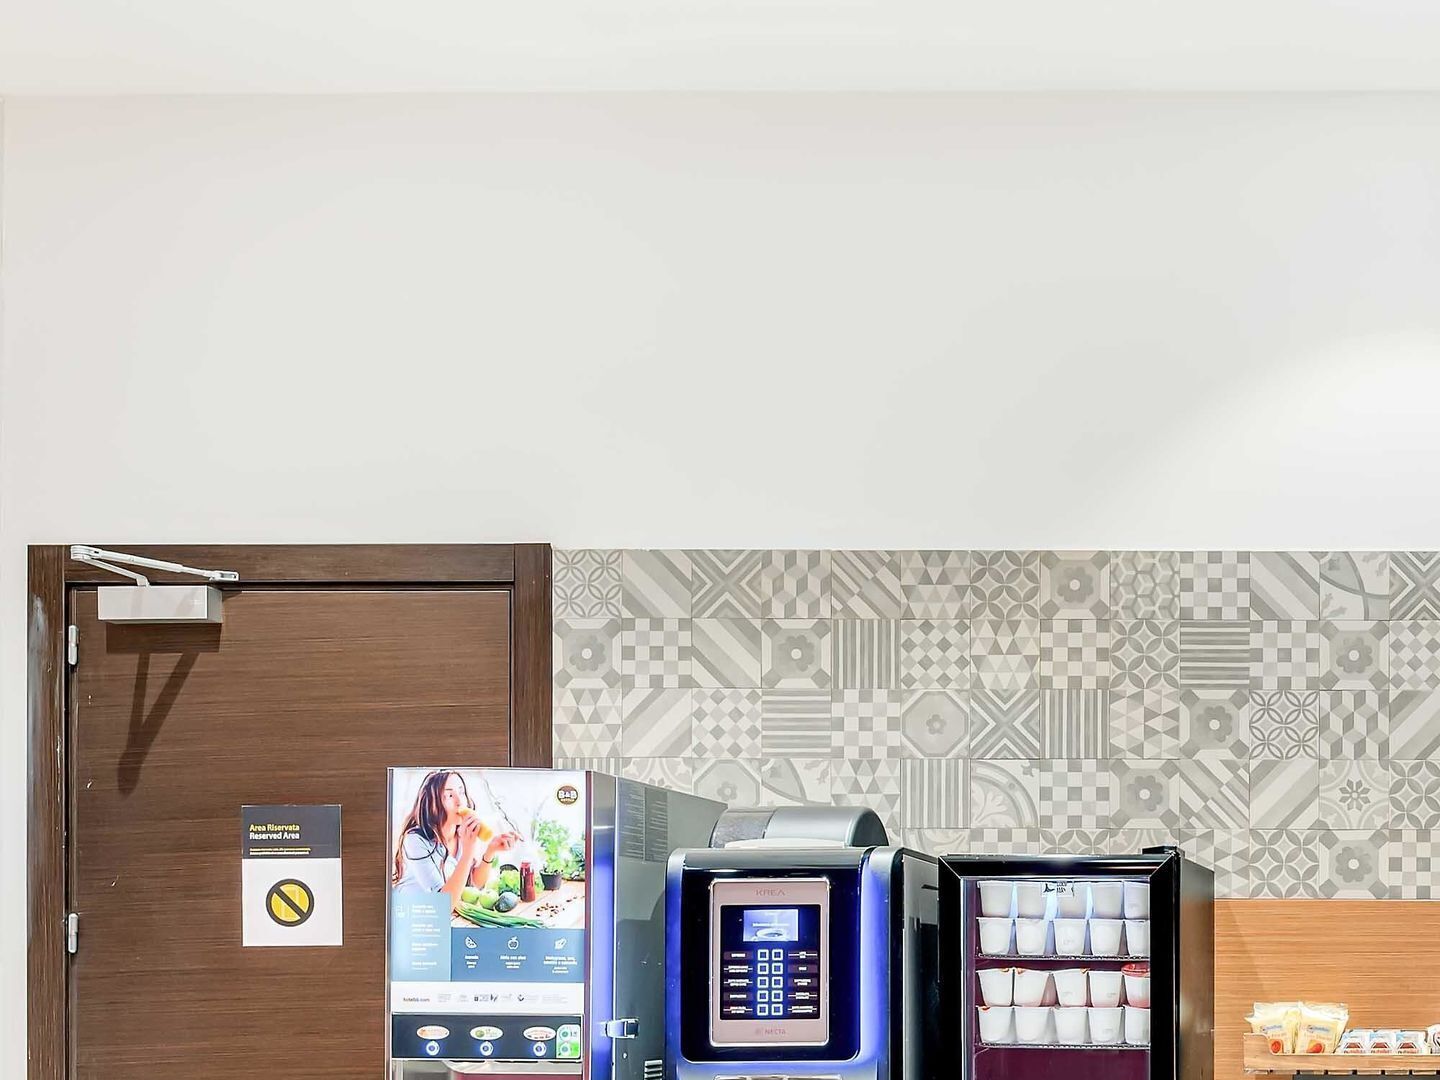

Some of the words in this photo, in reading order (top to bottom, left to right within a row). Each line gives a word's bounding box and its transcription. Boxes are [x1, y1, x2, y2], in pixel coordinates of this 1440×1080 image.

[558, 790, 577, 799] B&B
[267, 823, 300, 831] Riservata
[249, 832, 282, 840] Reserved
[283, 832, 300, 840] Area
[755, 888, 786, 897] KREA
